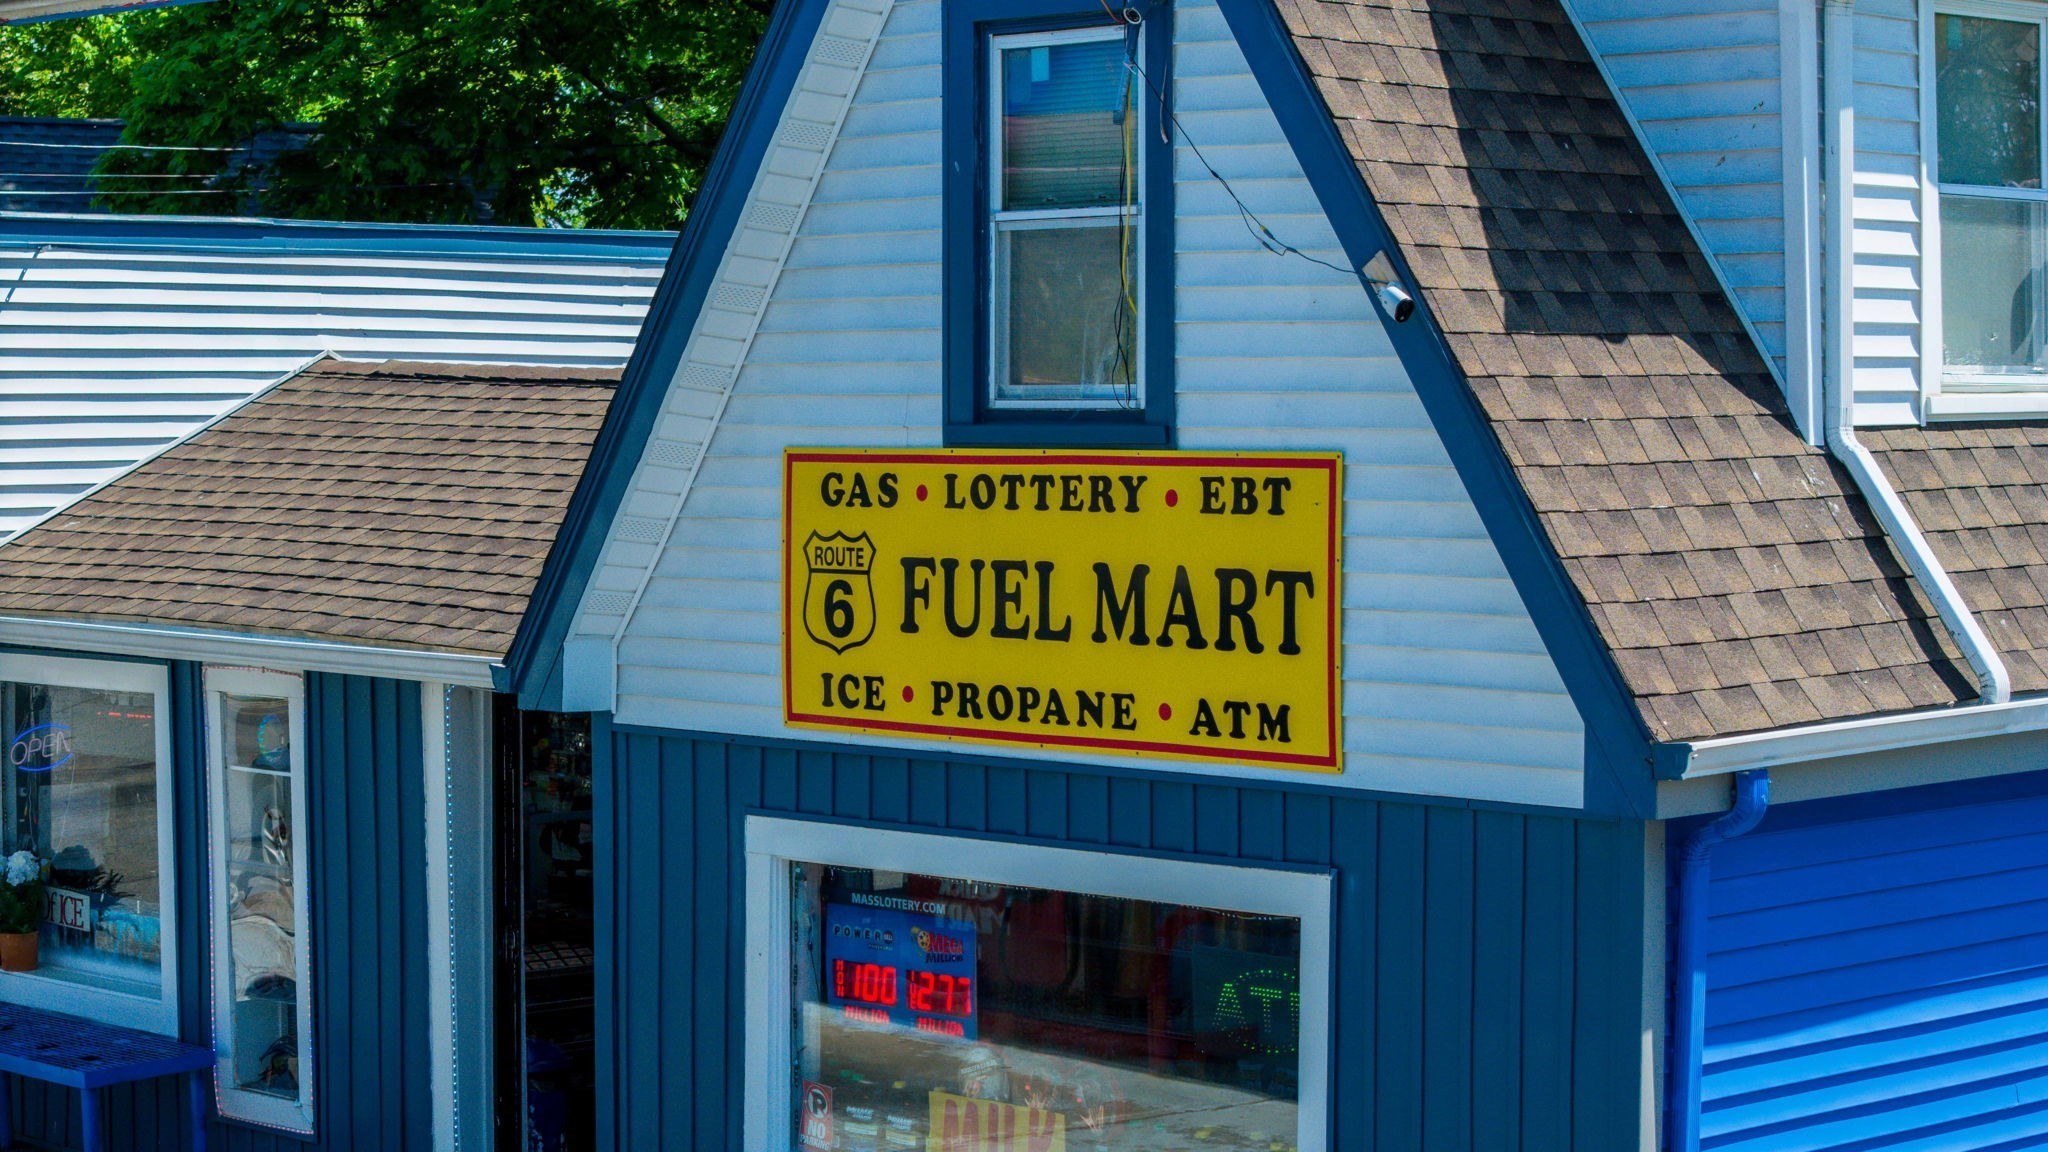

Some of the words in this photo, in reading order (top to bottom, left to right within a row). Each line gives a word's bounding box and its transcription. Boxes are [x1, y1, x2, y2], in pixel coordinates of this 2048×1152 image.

[821, 472, 899, 508] GAS
[943, 474, 1148, 513] LOTTERY
[1199, 476, 1292, 516] EBT
[814, 547, 864, 568] ROUTE
[823, 579, 855, 639] 6
[899, 556, 1072, 643] FUEL
[1091, 562, 1315, 656] MART
[820, 672, 886, 712] ICE
[930, 680, 1138, 731] PROPANE
[1188, 698, 1292, 743] ATM
[10, 731, 71, 766] OPEN
[59, 894, 84, 929] ICE
[851, 893, 946, 915] MASSLOTTERY.COM
[854, 963, 897, 1005] 100
[917, 971, 972, 1017] 277
[1212, 982, 1300, 1036] AT
[806, 1120, 826, 1140] NO
